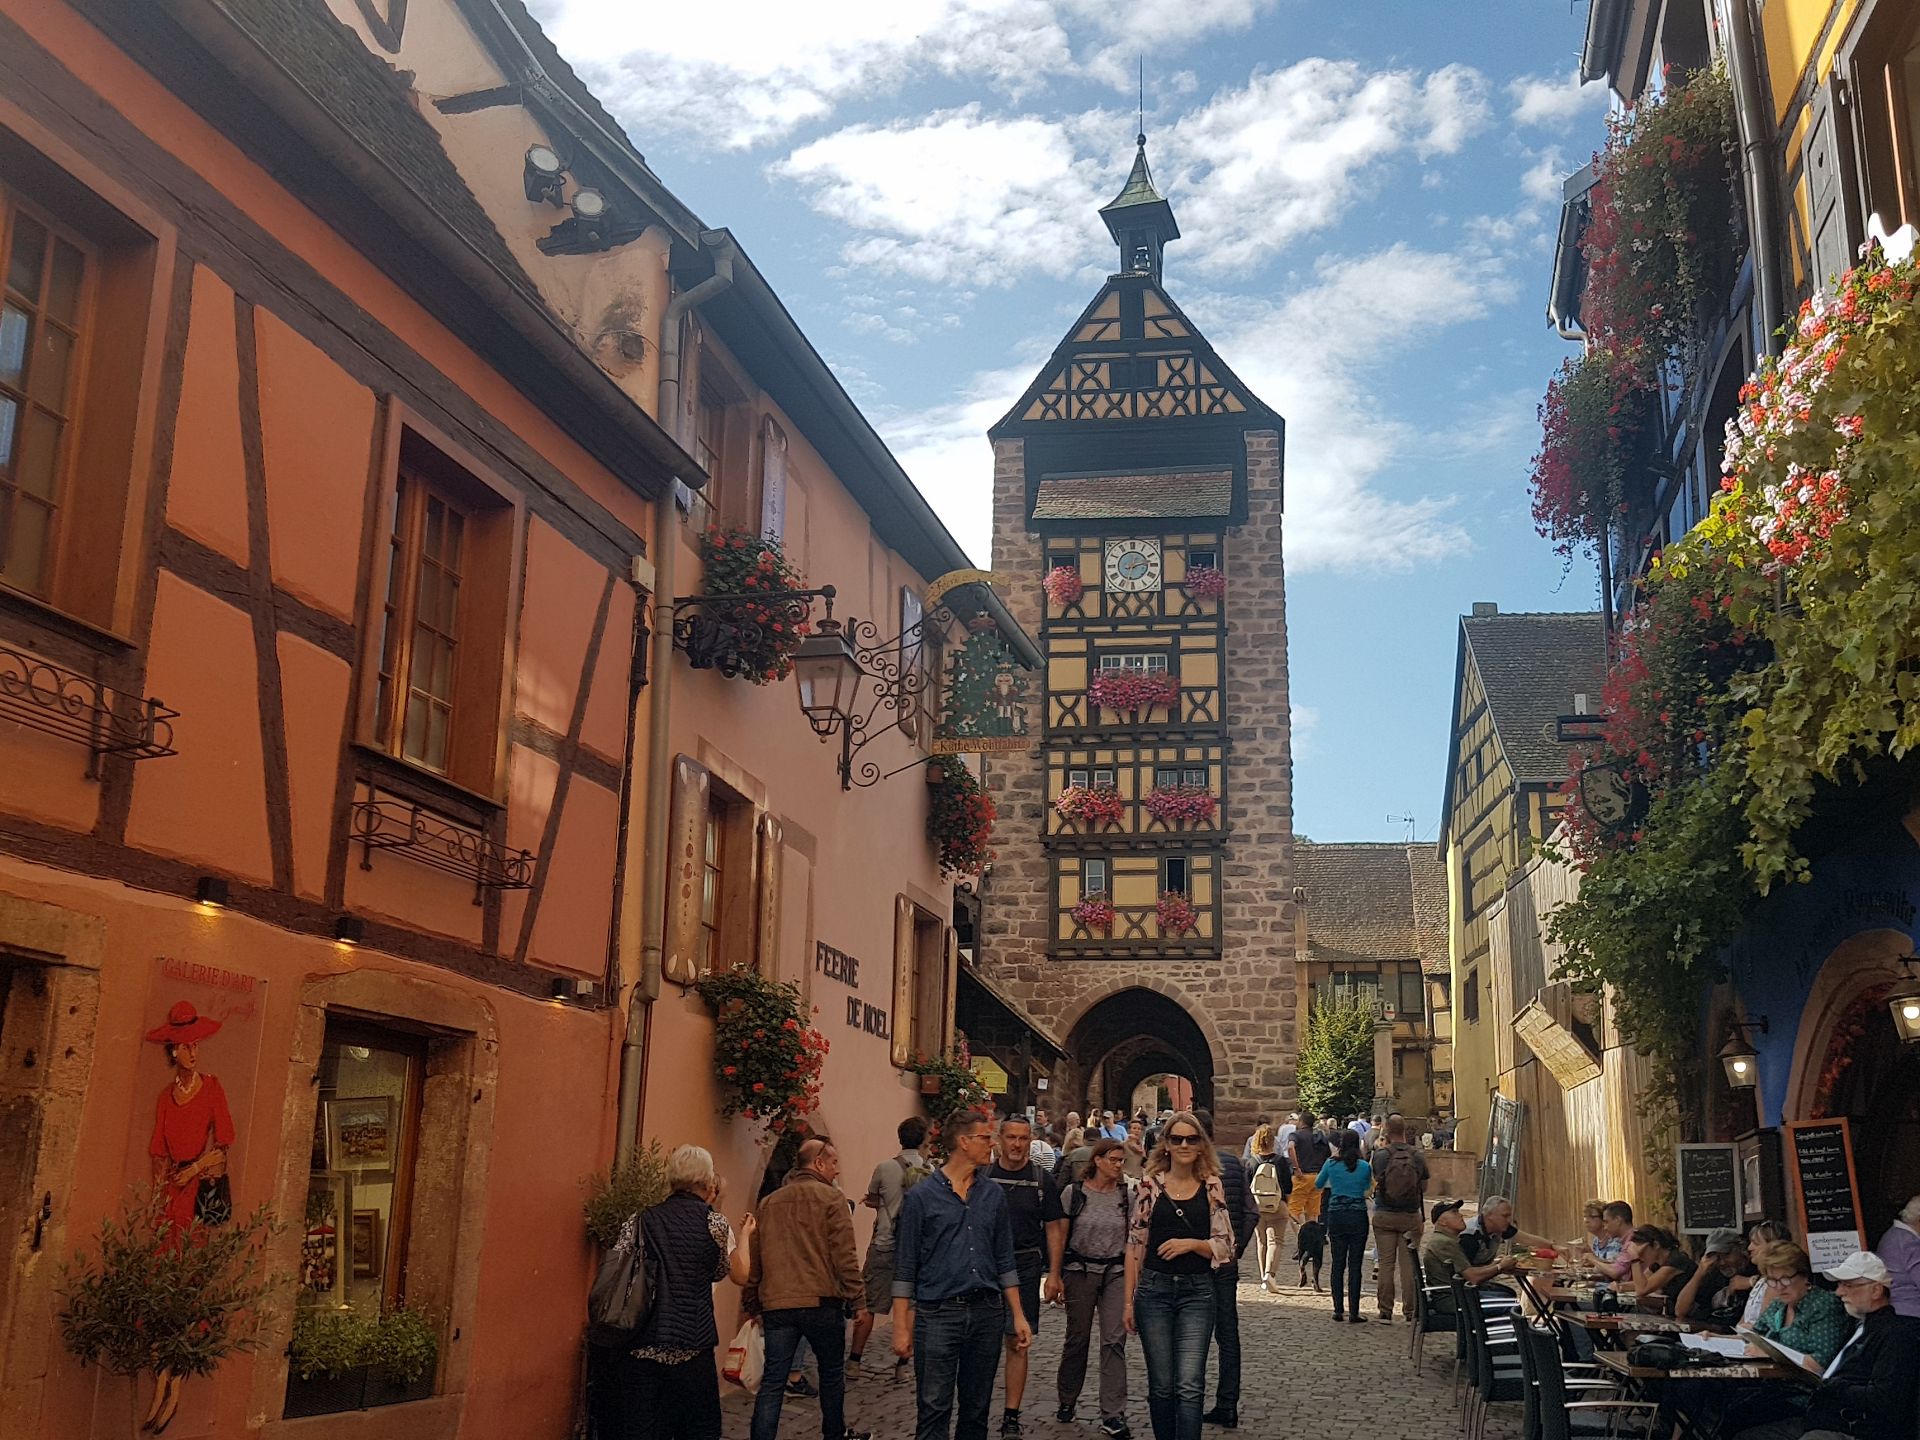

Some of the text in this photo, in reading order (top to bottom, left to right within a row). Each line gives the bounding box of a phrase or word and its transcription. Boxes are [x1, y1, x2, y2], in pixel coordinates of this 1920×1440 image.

[164, 958, 257, 992] GALERIE D'ART
[816, 940, 859, 988] FEERIE
[847, 996, 890, 1040] DE NOEL
